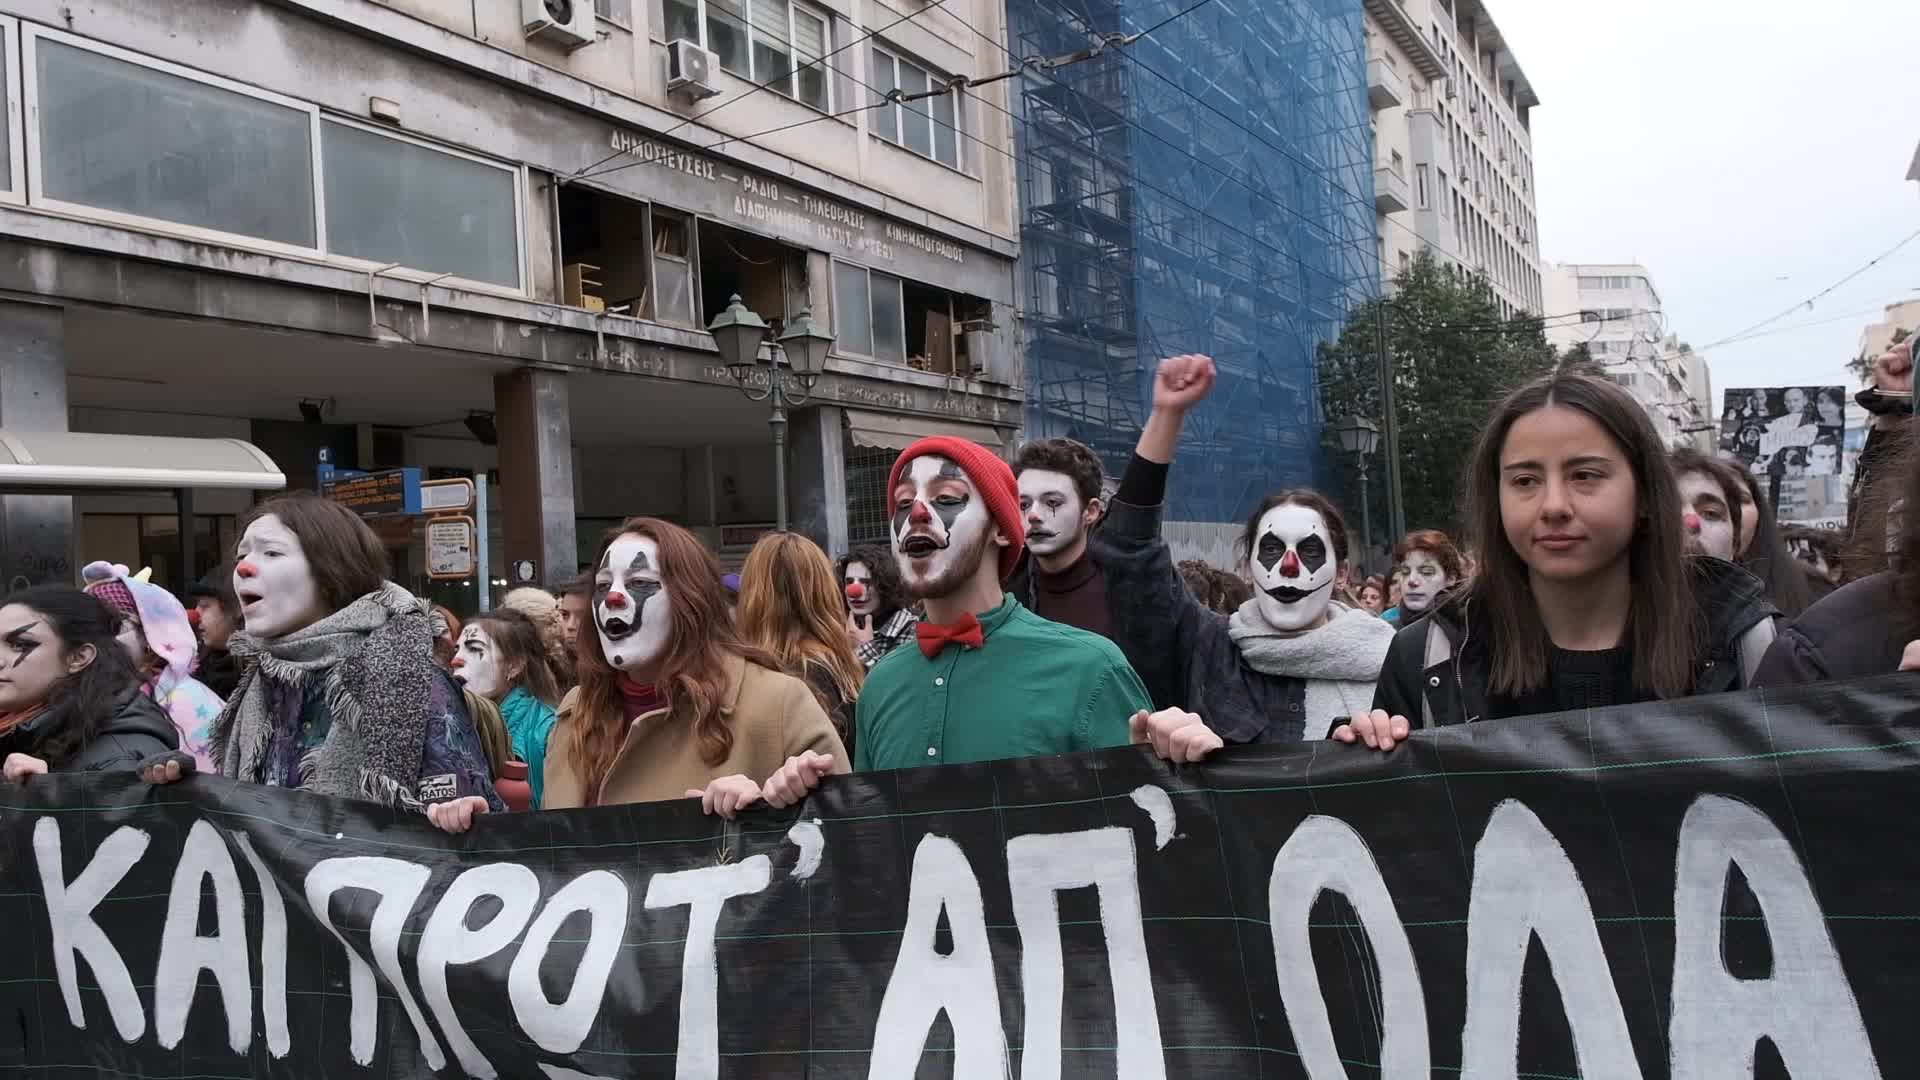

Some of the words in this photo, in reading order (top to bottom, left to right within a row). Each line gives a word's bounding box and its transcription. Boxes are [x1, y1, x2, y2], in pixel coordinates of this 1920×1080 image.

[611, 130, 716, 180] ΔΗΜΟΣΙΕΥΣΕΙΣ
[743, 175, 778, 200] ΡΑΔΙΟ
[33, 815, 290, 1058] ΚΑΙ
[1269, 793, 1881, 1080] ΟΛΑ
